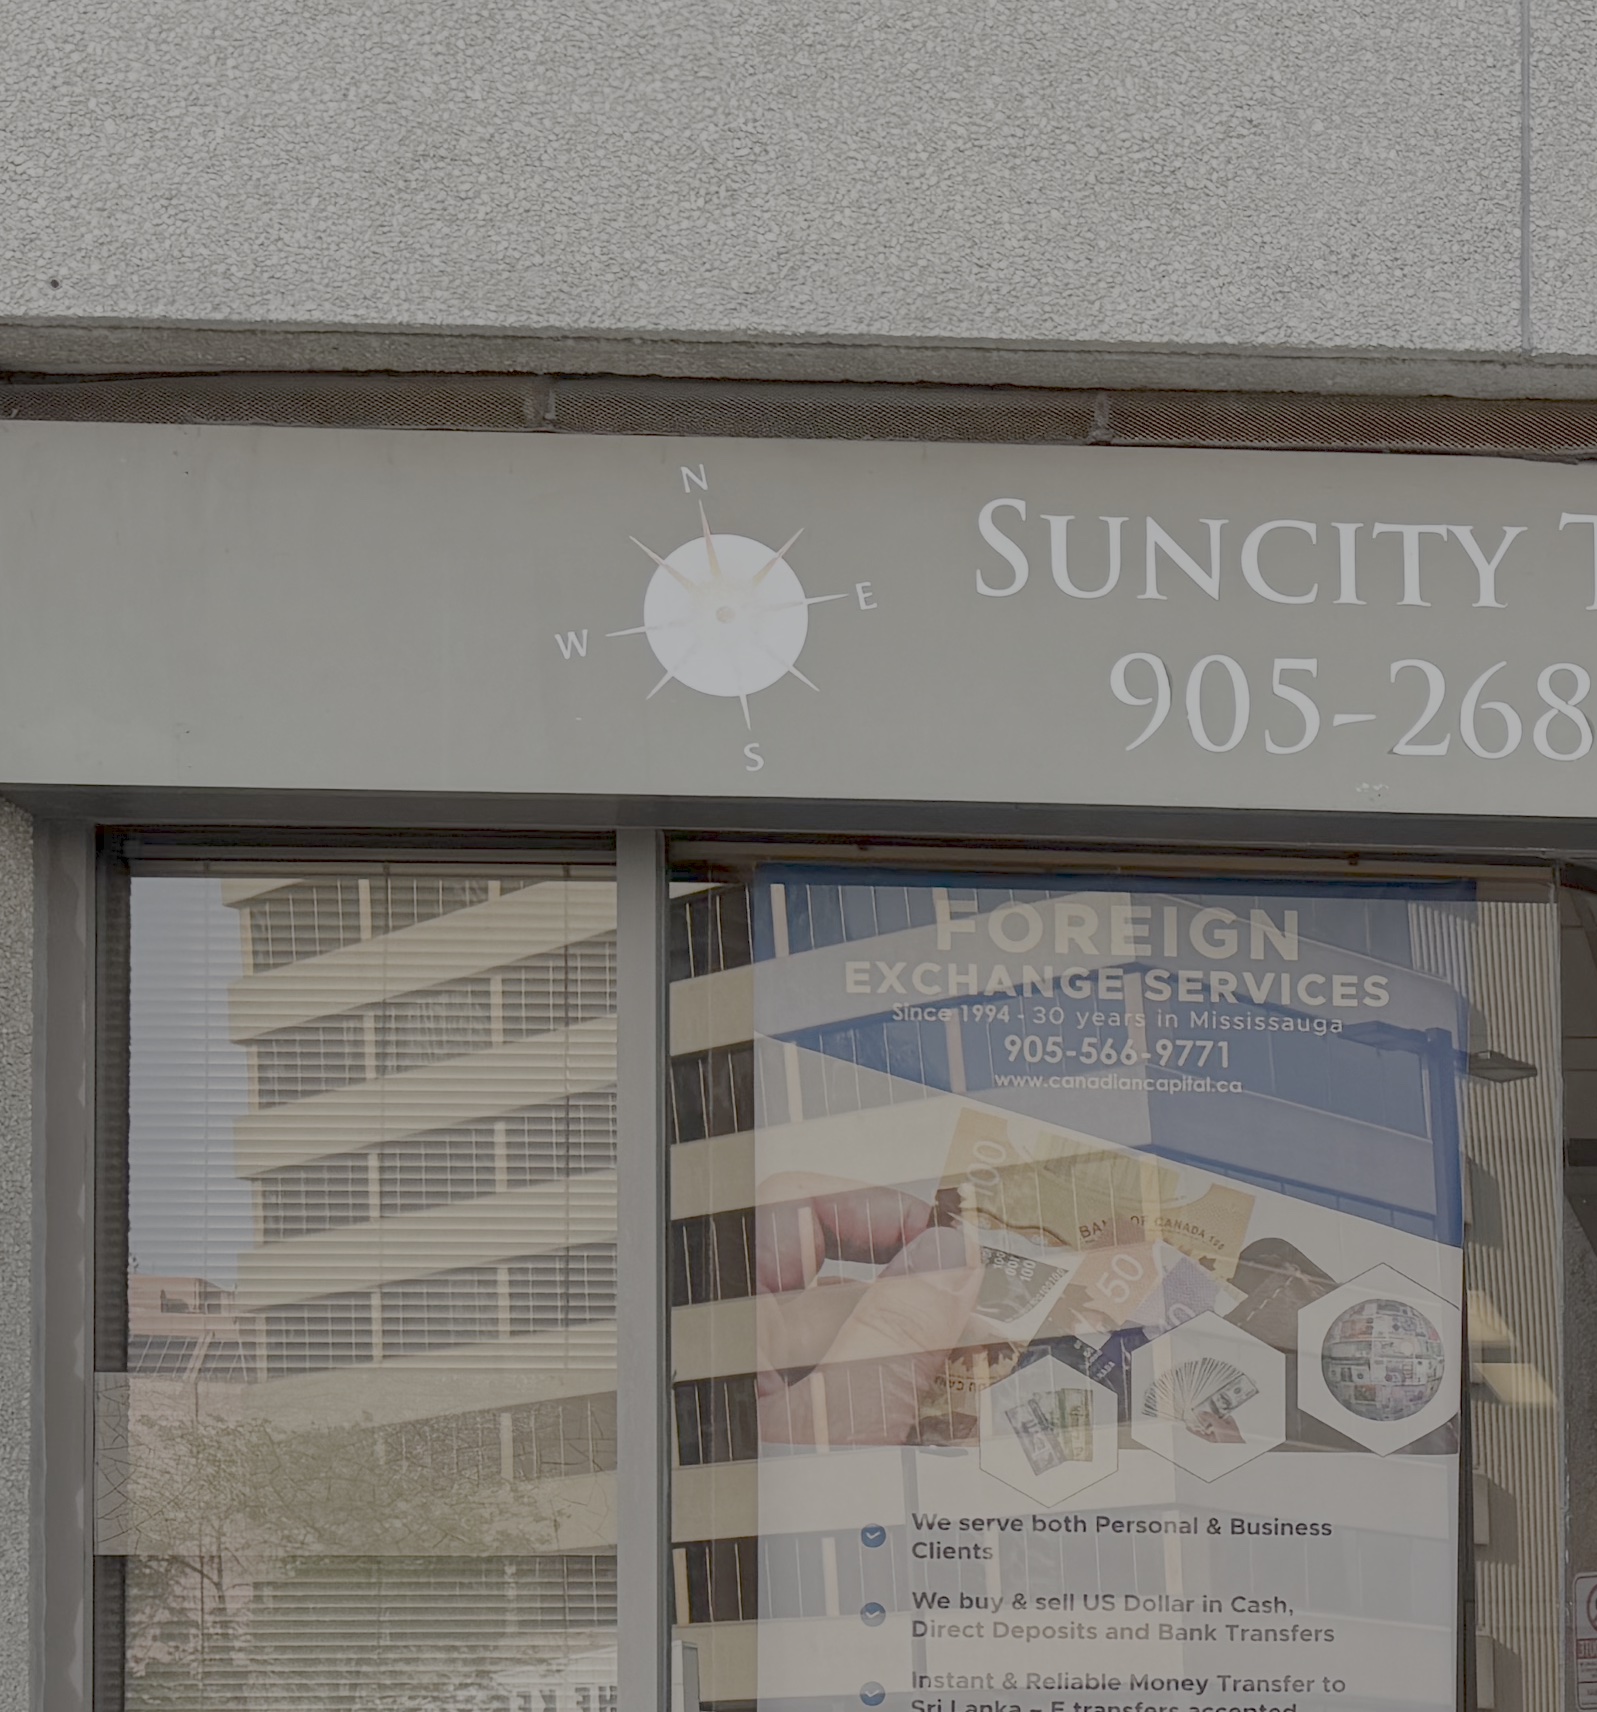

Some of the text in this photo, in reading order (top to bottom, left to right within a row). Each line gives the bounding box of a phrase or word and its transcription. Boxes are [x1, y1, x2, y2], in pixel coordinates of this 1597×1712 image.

[681, 463, 710, 494] N
[973, 497, 1531, 610] SUNCITY
[856, 581, 881, 613] E
[553, 630, 590, 662] W
[742, 743, 767, 773] S
[935, 898, 1301, 962] FOREIGN
[844, 960, 1392, 1008] EXCHANGE SERVICES
[892, 1002, 952, 1024] Since
[959, 1004, 1010, 1025] 1994
[1033, 1007, 1066, 1027] 30
[1076, 1009, 1147, 1033] years
[1156, 1010, 1180, 1029] in
[1189, 1012, 1345, 1037] Mississauga
[1004, 1034, 1232, 1068] 905-566-9771
[994, 1072, 1243, 1097] www.canadiancapital.ca
[911, 1513, 1333, 1537] We serve both Personal & Business
[911, 1541, 994, 1561] Clients
[911, 1591, 1295, 1617] We buy & sell US Dollar in Cash,
[911, 1621, 1335, 1646] Direct Deposits and Bank Transfers
[911, 1671, 1346, 1697] Instant & Reliable Money Transfer to
